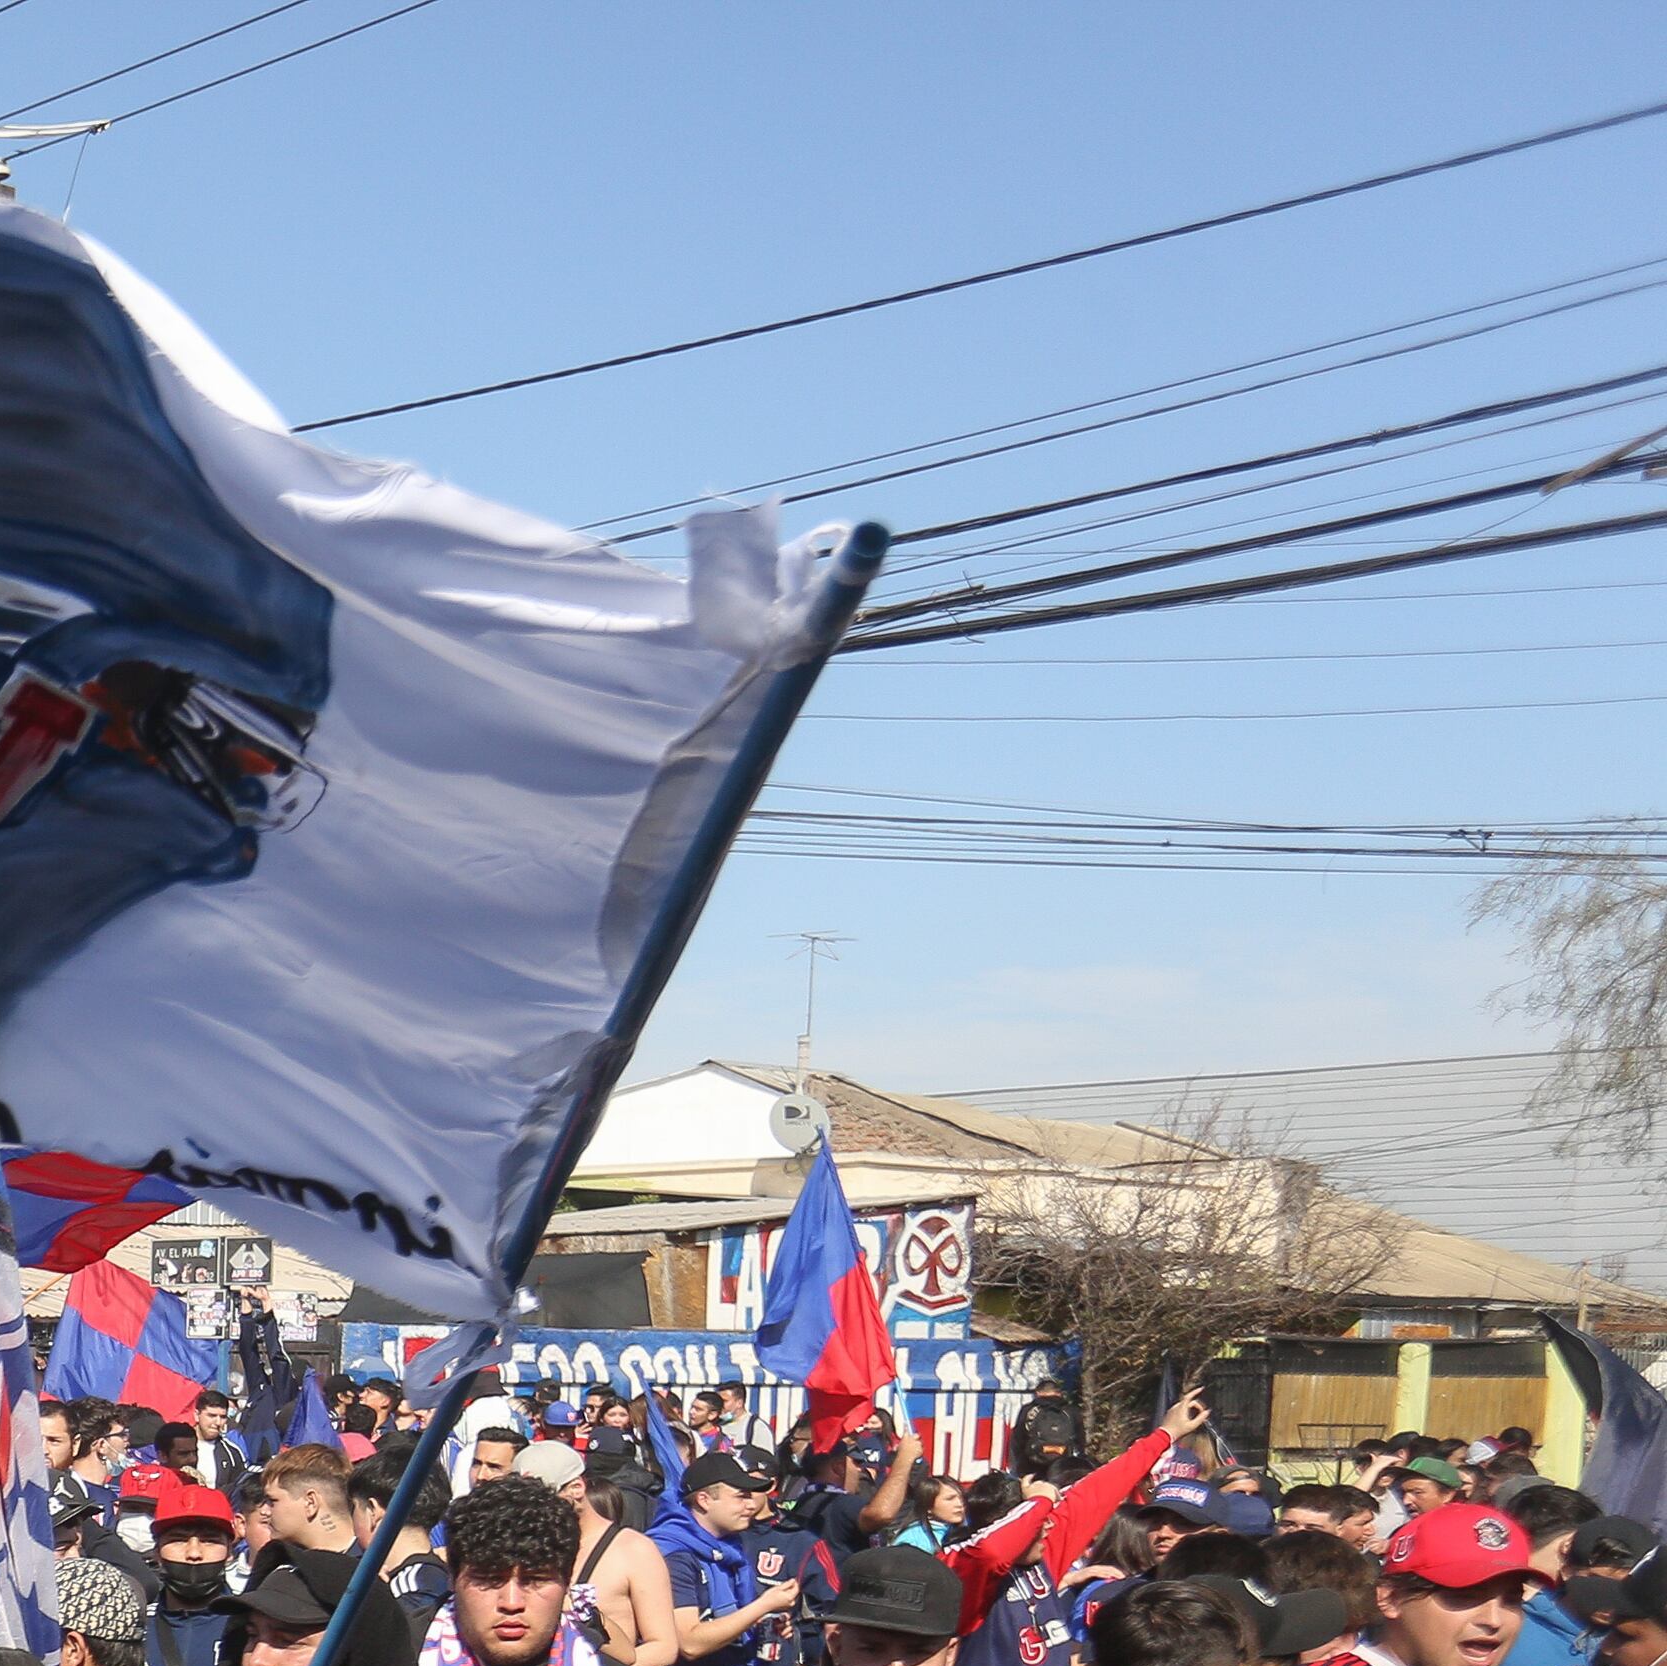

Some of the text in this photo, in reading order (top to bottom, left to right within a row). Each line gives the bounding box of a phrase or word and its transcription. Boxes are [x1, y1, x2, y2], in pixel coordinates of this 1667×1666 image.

[154, 1248, 167, 1259] AV
[169, 1248, 180, 1258] EL
[756, 1551, 785, 1578] U
